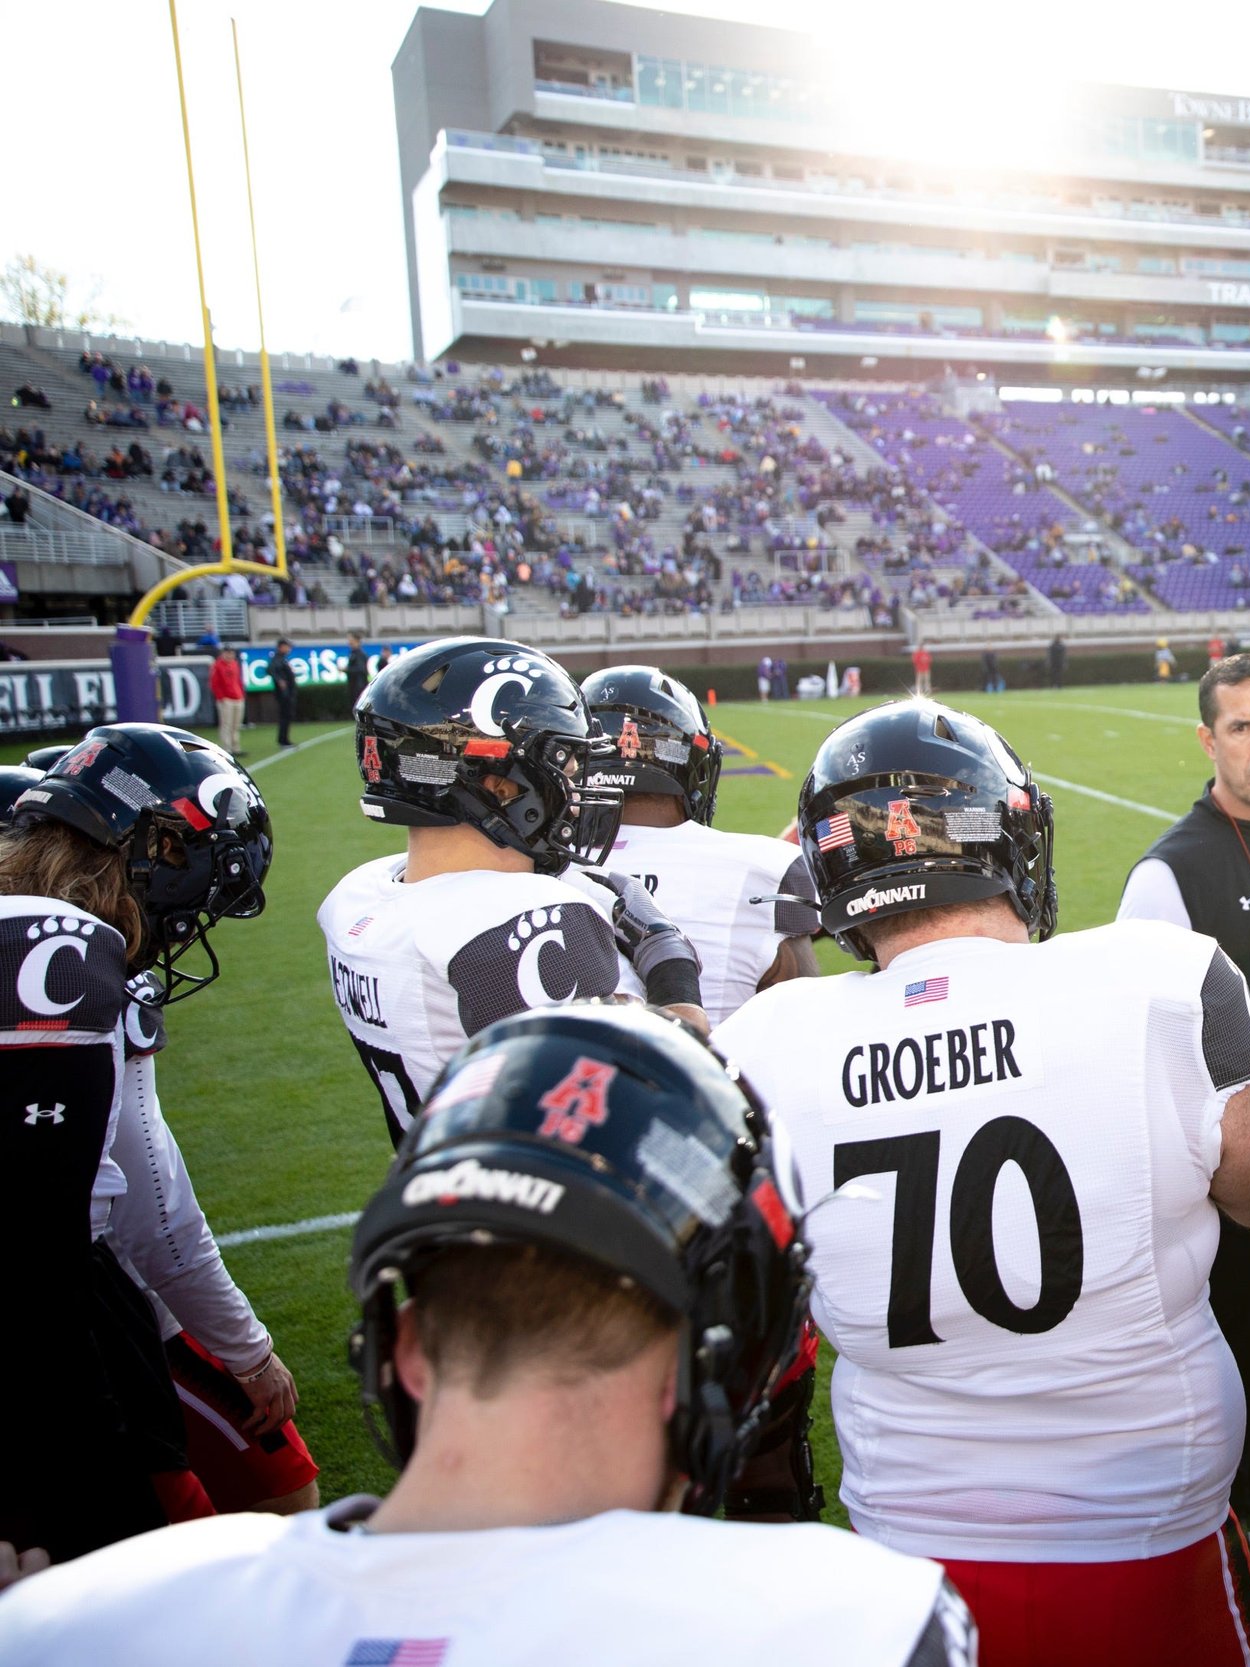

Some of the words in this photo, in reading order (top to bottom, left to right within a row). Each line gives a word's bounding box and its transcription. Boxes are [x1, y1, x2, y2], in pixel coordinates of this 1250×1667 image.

[74, 667, 201, 722] FID
[580, 771, 636, 786] NCINNATI
[847, 884, 926, 917] CINCINNATI
[842, 1018, 1022, 1108] GROEBER
[402, 1159, 566, 1215] CINCINNATI
[833, 1114, 1084, 1349] 70
